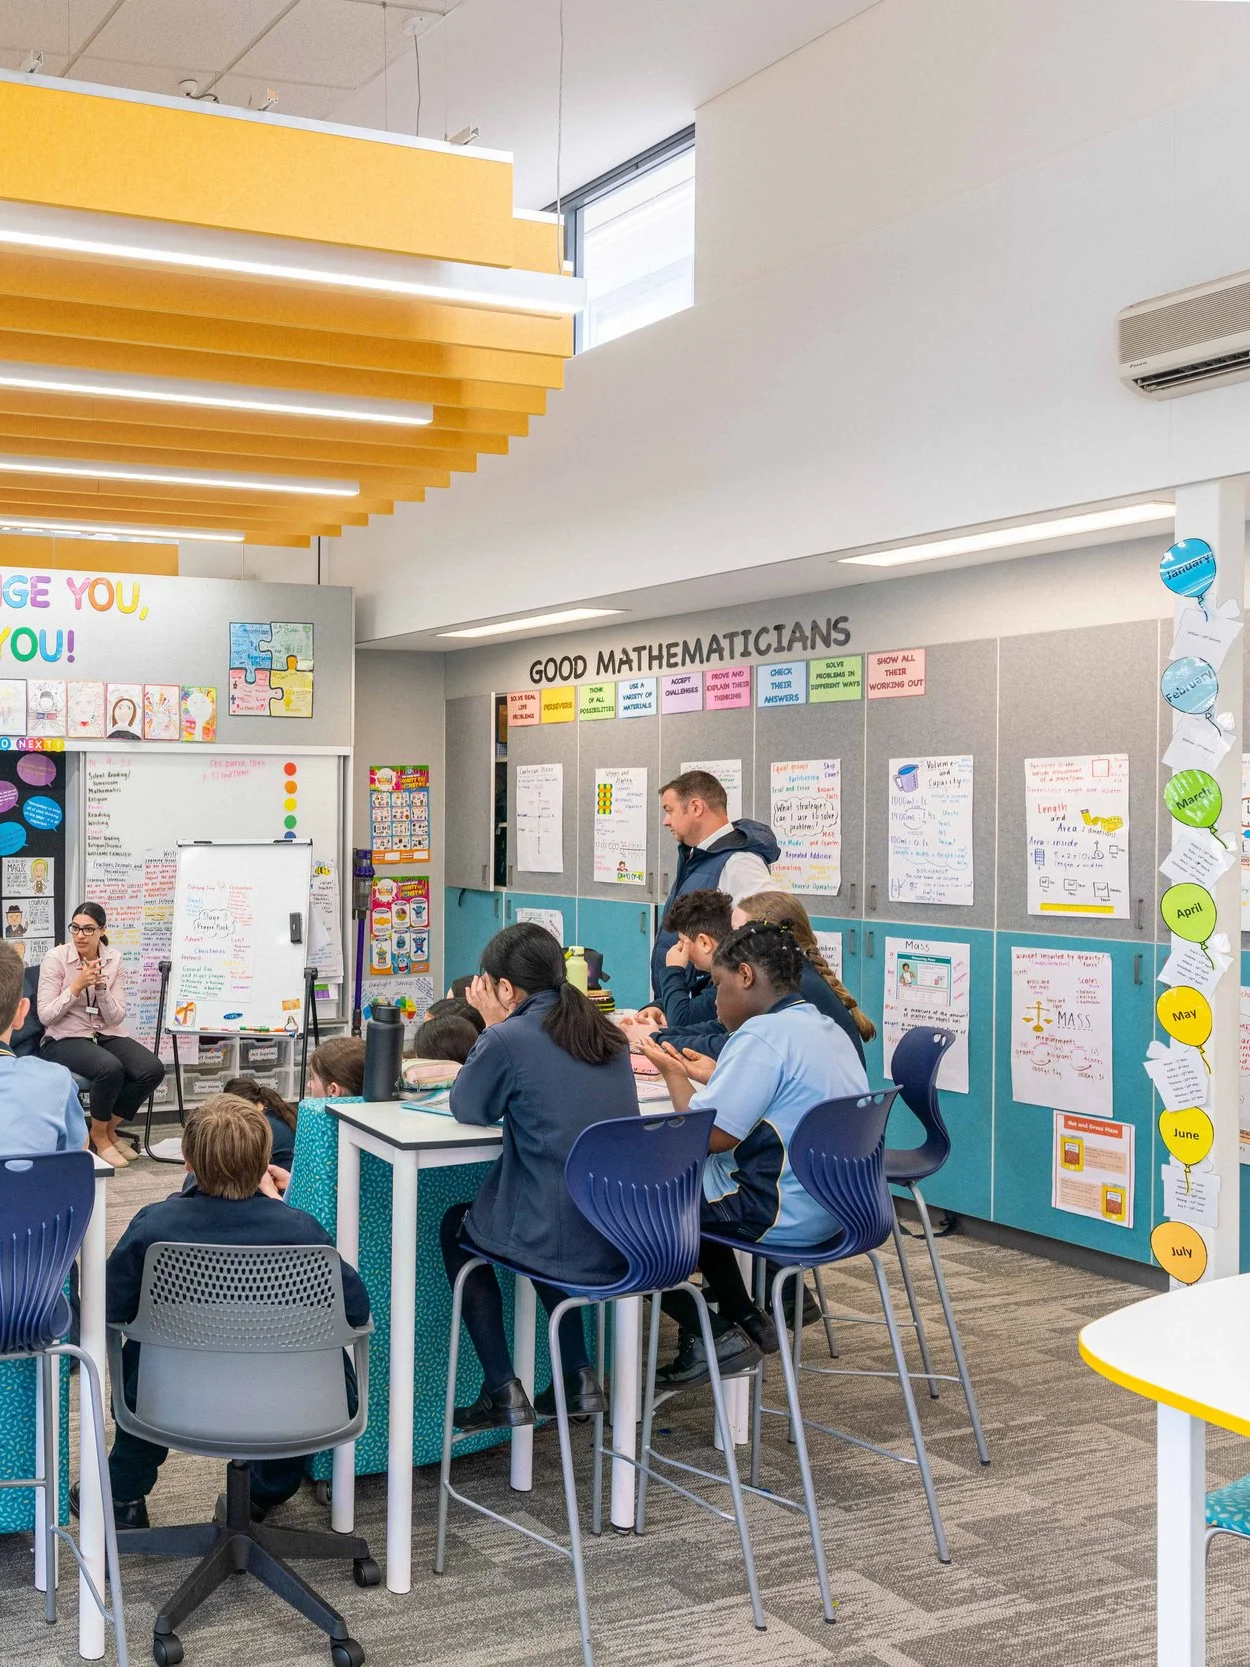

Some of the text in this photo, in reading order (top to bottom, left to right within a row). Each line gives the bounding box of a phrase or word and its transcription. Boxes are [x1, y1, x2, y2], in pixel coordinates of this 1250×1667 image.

[1166, 552, 1211, 580] January
[66, 576, 149, 621] YOU,
[529, 615, 851, 685] GOOD MATHEMATICIANS
[877, 656, 898, 665] SHOW
[711, 672, 730, 680] PROVE
[770, 668, 793, 677] CHECK
[816, 671, 846, 679] PROBLEMS
[885, 668, 906, 677] THEIR
[671, 677, 691, 685] ACCEPT
[732, 681, 750, 689] THEIR
[771, 681, 792, 690] THEIR
[811, 682, 840, 690] DIFFERENT
[869, 679, 923, 690] WORKING OUT
[665, 687, 699, 697] CHALLENGES
[1165, 670, 1213, 704] February
[714, 693, 742, 701] THINKING
[764, 694, 799, 703] ANSWERS
[543, 702, 573, 711] PERSEVERE
[580, 706, 614, 714] POSSIBILITIES
[623, 703, 652, 711] MATERIALS
[18, 739, 61, 749] NEXT?
[1175, 787, 1212, 811] March
[776, 803, 827, 815] What strategies
[1037, 803, 1068, 816] Length
[812, 812, 819, 820] to
[821, 811, 834, 821] solve
[790, 822, 818, 833] problems?
[1057, 822, 1077, 833] Area
[1176, 902, 1204, 920] April
[905, 940, 930, 952] Mass
[1057, 1010, 1092, 1029] MASS
[1172, 1008, 1197, 1022] May
[1173, 1127, 1200, 1141] June
[1171, 1245, 1193, 1259] July
